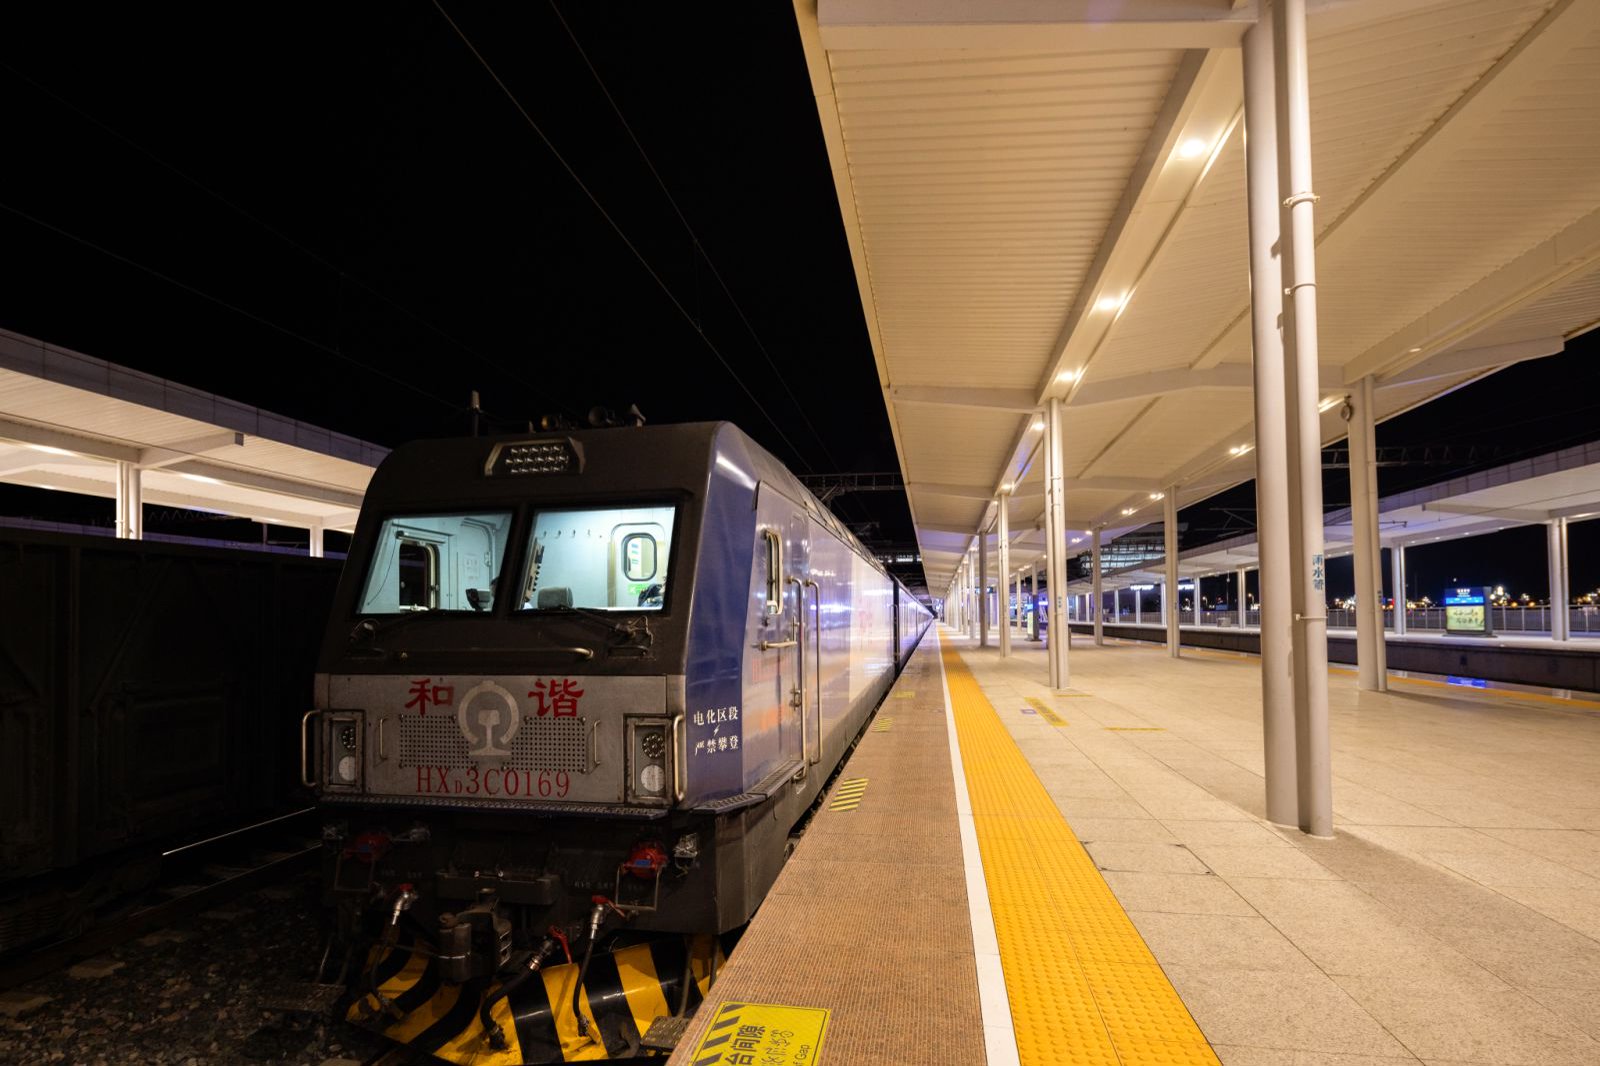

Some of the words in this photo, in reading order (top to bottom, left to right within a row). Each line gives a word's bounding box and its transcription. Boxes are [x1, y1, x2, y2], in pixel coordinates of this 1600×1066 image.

[404, 678, 454, 718] 和
[527, 678, 585, 718] 谐
[693, 706, 738, 726] 电化区段
[694, 735, 738, 756] 严禁攀登
[416, 767, 570, 798] HXD3C0169
[794, 1044, 811, 1060] Gap
